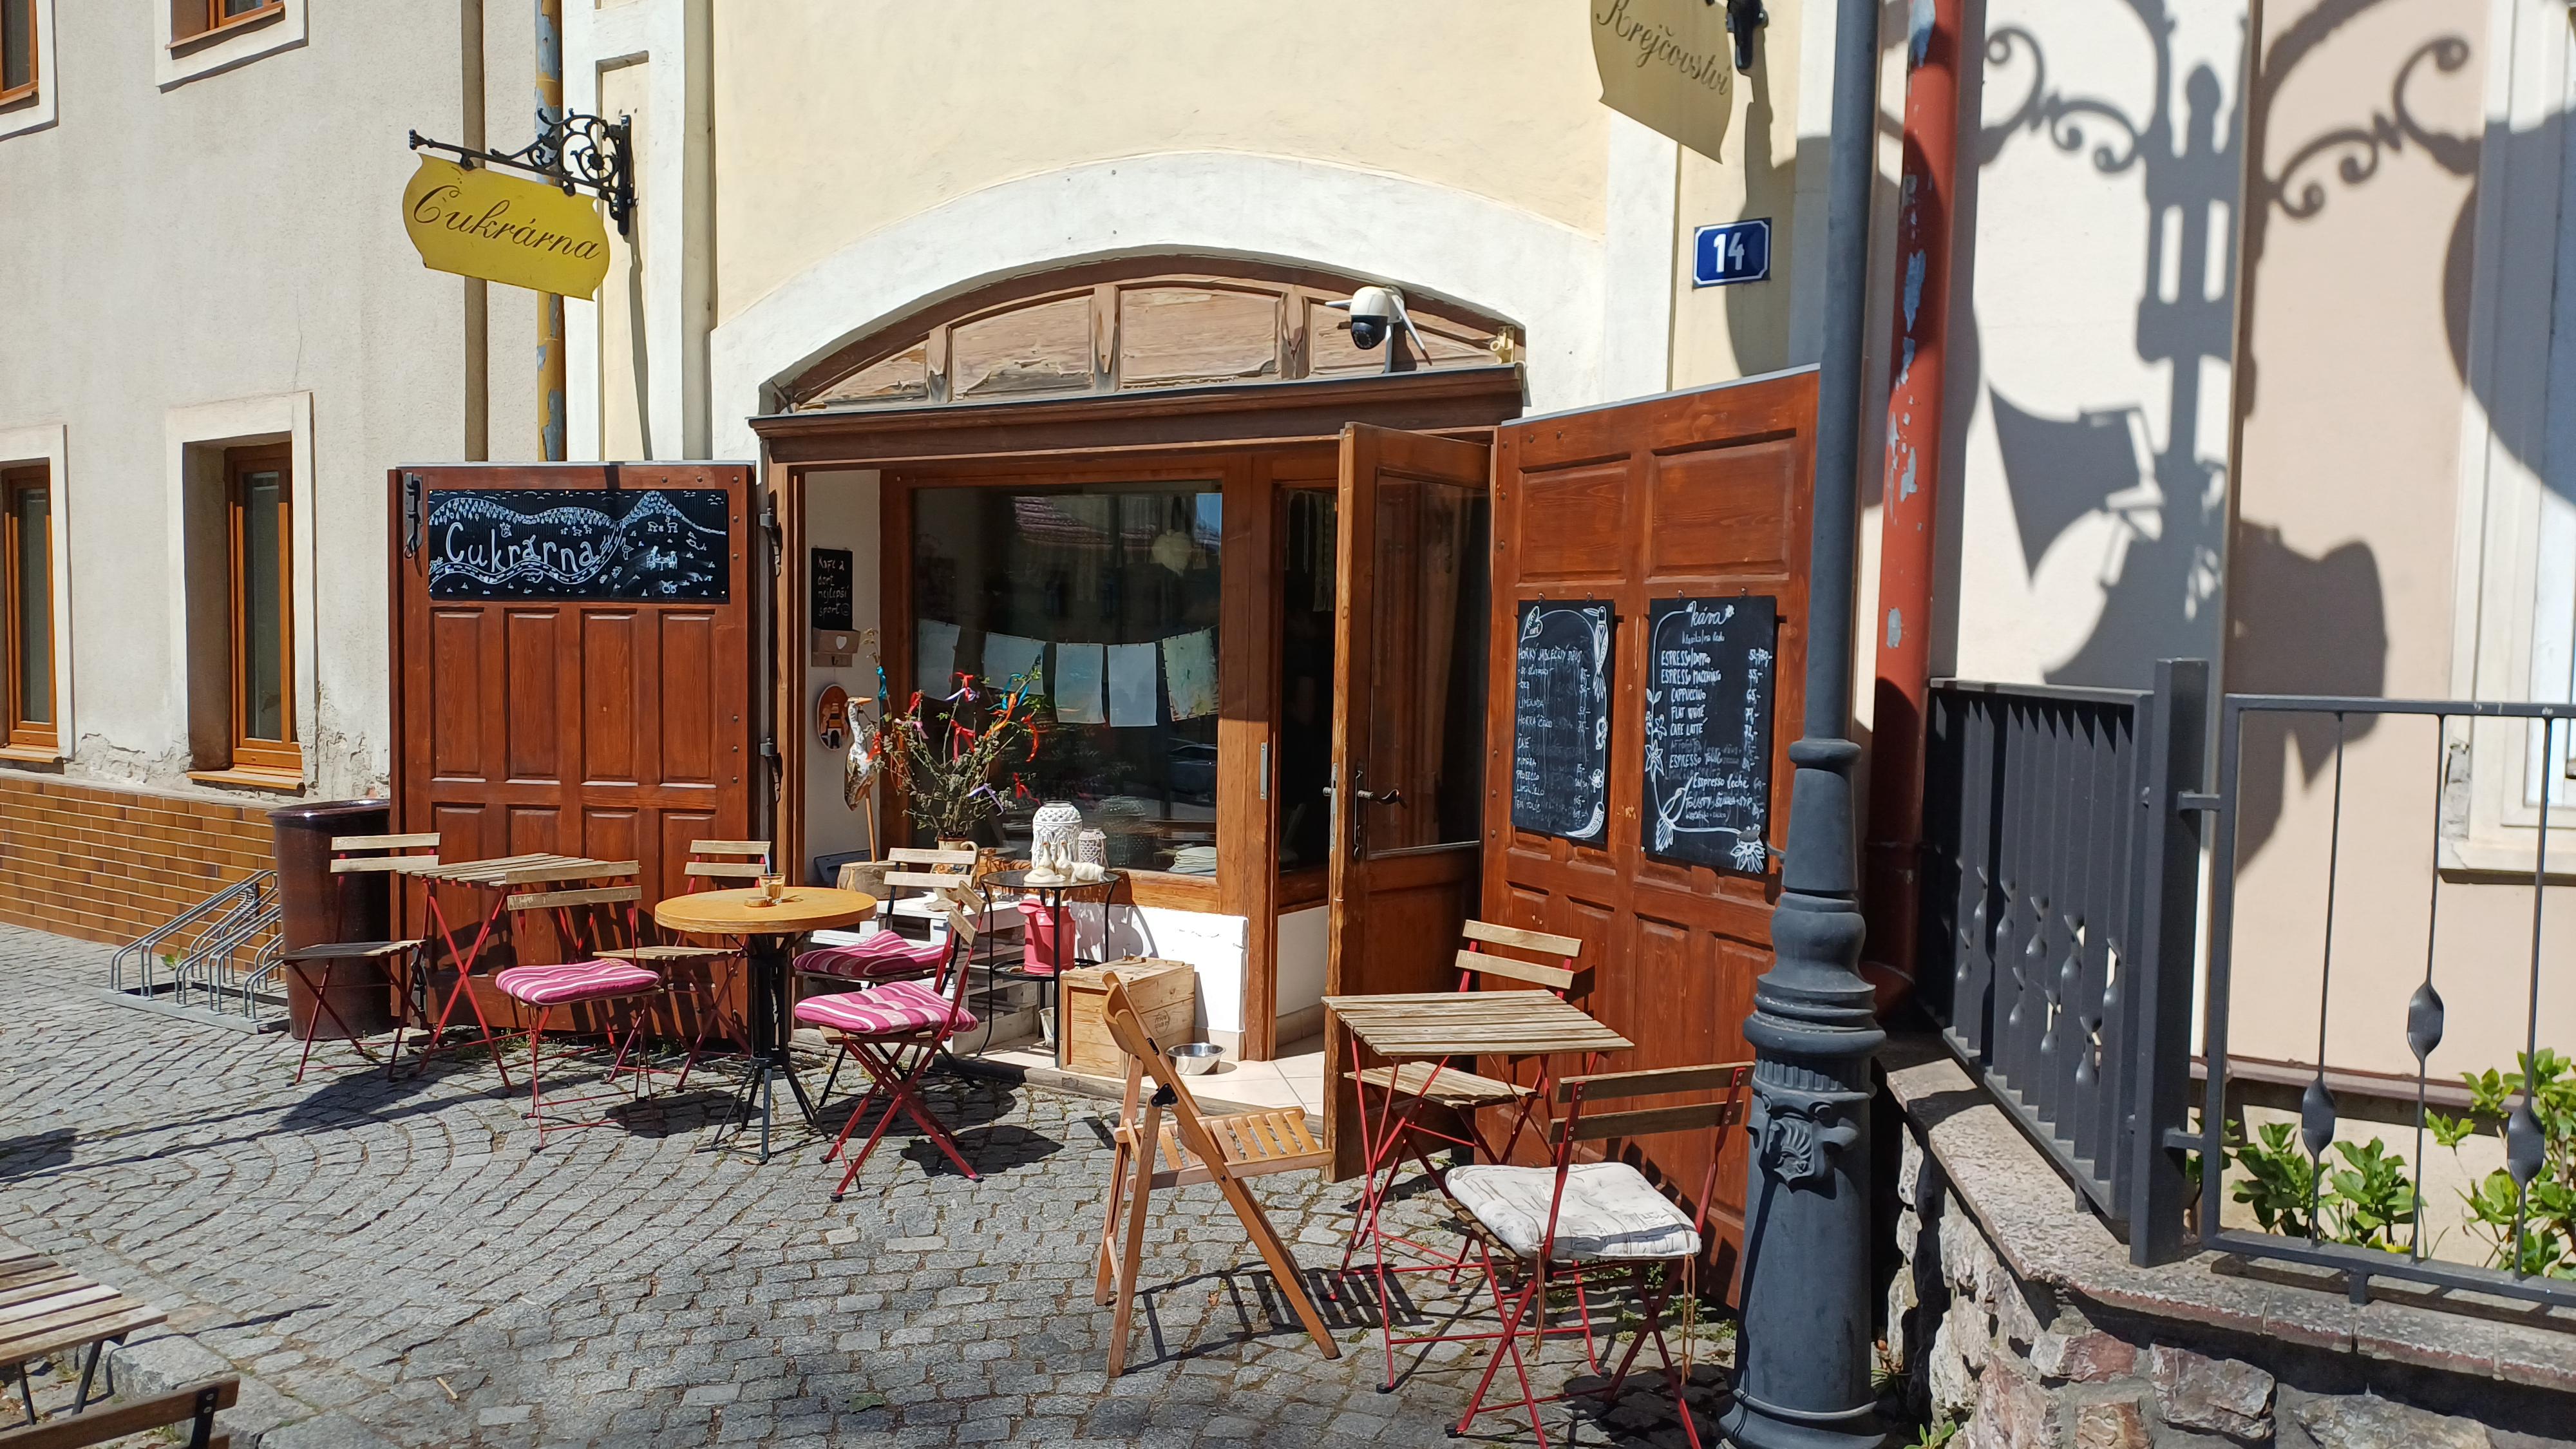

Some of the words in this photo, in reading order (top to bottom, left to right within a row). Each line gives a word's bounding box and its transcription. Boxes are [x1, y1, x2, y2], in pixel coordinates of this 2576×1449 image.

[413, 185, 601, 260] Cukrárna
[1713, 232, 1745, 273] 14
[446, 522, 601, 573] Cukrárna
[1687, 601, 1728, 628] káva
[1661, 668, 1692, 685] ESPRESSO
[1671, 686, 1707, 703] CAPPUCCINO
[1671, 706, 1686, 723] FLAT
[1669, 753, 1702, 768] ESPRESSO
